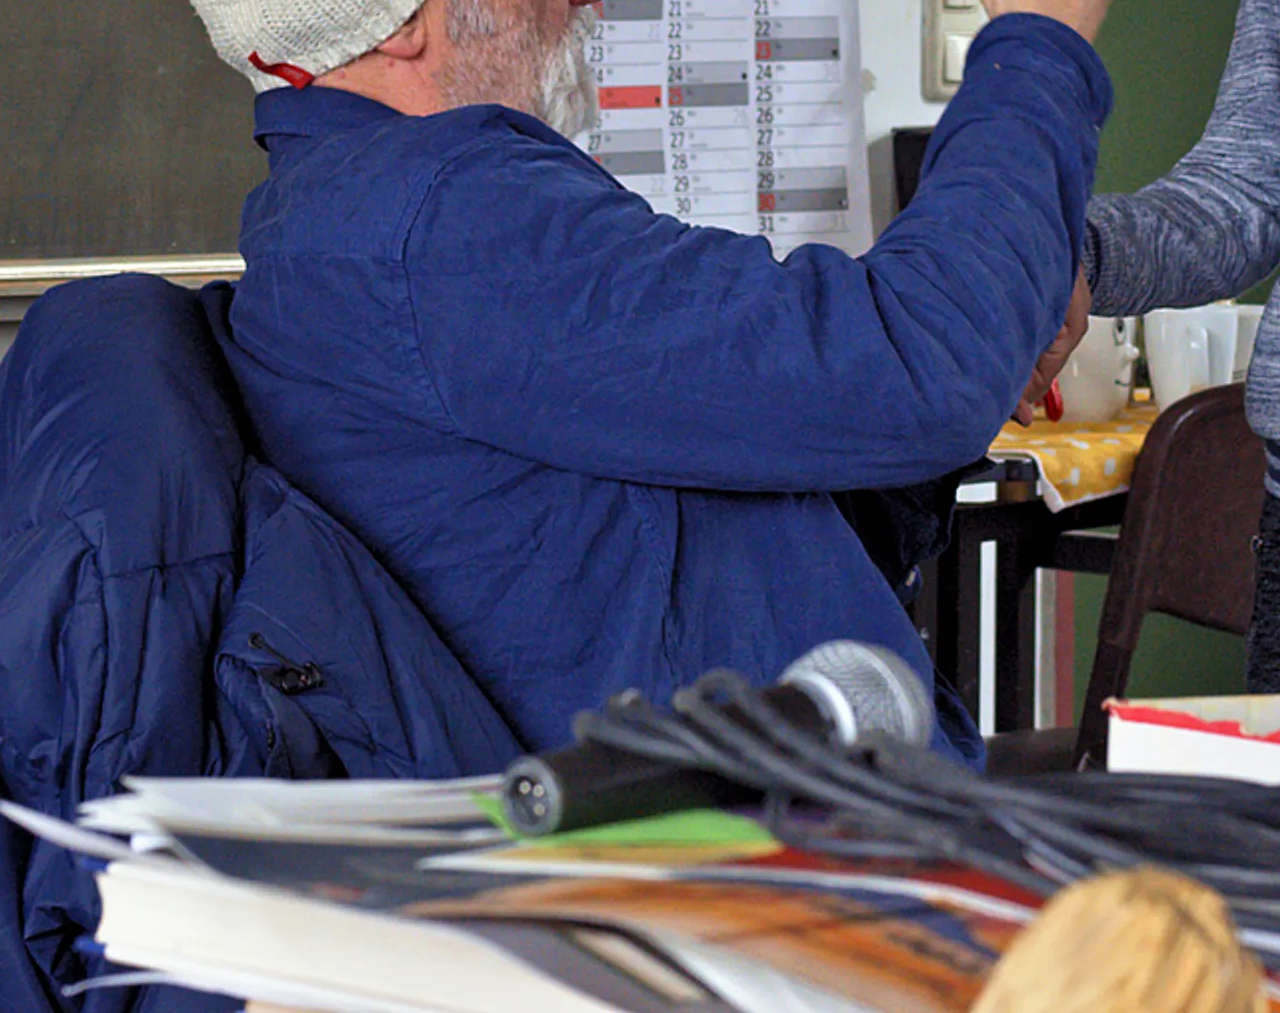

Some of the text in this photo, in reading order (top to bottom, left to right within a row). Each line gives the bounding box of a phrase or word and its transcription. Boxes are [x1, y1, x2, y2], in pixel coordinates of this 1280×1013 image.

[669, 1, 682, 17] 21
[754, 0, 769, 16] 21
[669, 23, 682, 38] 22
[755, 20, 771, 37] 22
[589, 46, 604, 62] 23
[668, 45, 682, 60] 23
[755, 41, 771, 60] 23
[668, 66, 683, 82] 24
[756, 64, 772, 81] 24
[756, 85, 773, 102] 25
[670, 110, 685, 127] 26
[756, 107, 774, 124] 26
[588, 135, 602, 152] 27
[671, 131, 685, 148] 27
[757, 129, 773, 146] 27
[672, 153, 688, 170] 28
[757, 151, 774, 167] 28
[674, 175, 690, 192] 29
[757, 171, 775, 188] 29
[676, 197, 691, 214] 30
[758, 193, 776, 212] 30
[758, 216, 774, 232] 31
